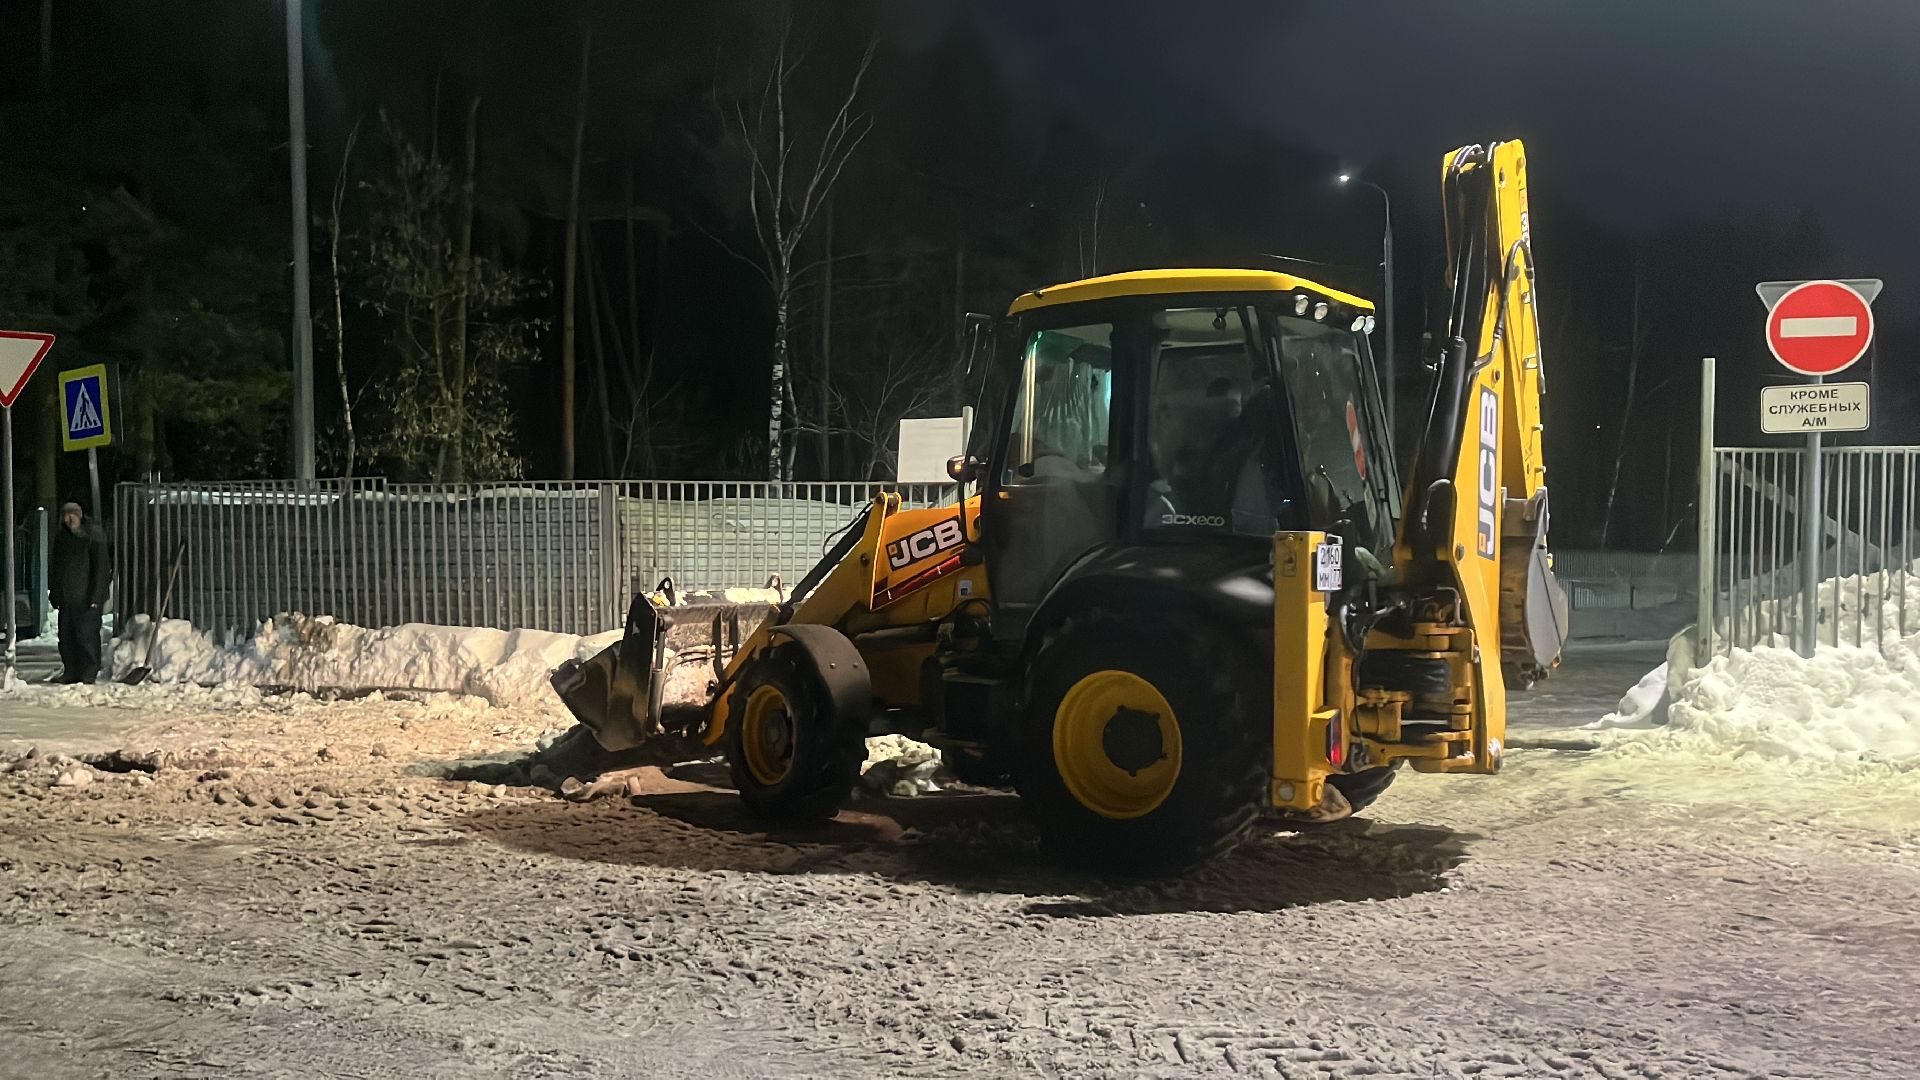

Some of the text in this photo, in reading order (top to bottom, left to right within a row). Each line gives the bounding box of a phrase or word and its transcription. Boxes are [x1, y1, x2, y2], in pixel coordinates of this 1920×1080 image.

[1790, 389, 1839, 400] КРОМЕ
[1769, 402, 1861, 415] СЛУЖЕБНЫХ
[1802, 417, 1827, 427] А/М
[1478, 391, 1498, 556] JCB
[888, 519, 963, 568] JCB
